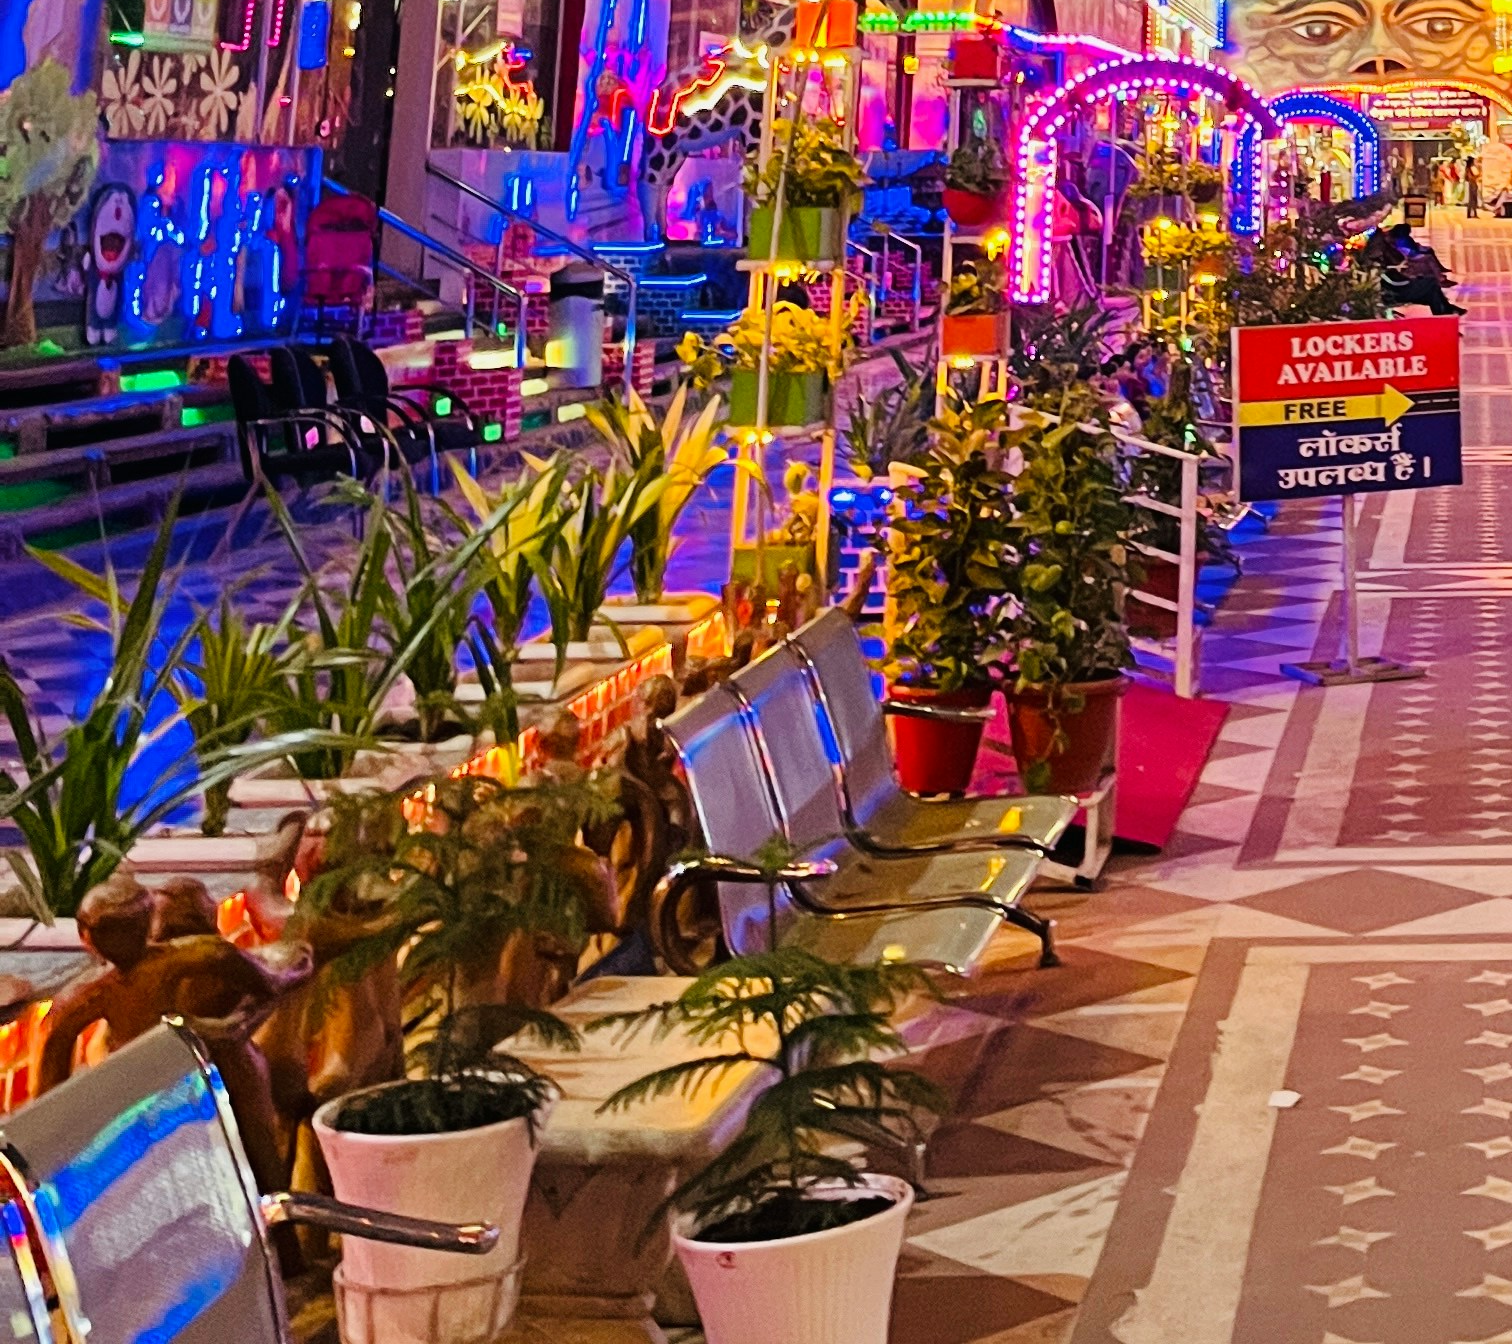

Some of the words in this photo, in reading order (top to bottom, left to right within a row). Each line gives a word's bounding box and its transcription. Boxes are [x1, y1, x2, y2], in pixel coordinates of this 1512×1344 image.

[1290, 330, 1414, 359] LOCKERS
[1277, 355, 1428, 386] AVAILABLE
[1284, 400, 1347, 421] FREE
[1297, 423, 1403, 458] लॉकर्स
[1278, 462, 1386, 490] उपलब्ध
